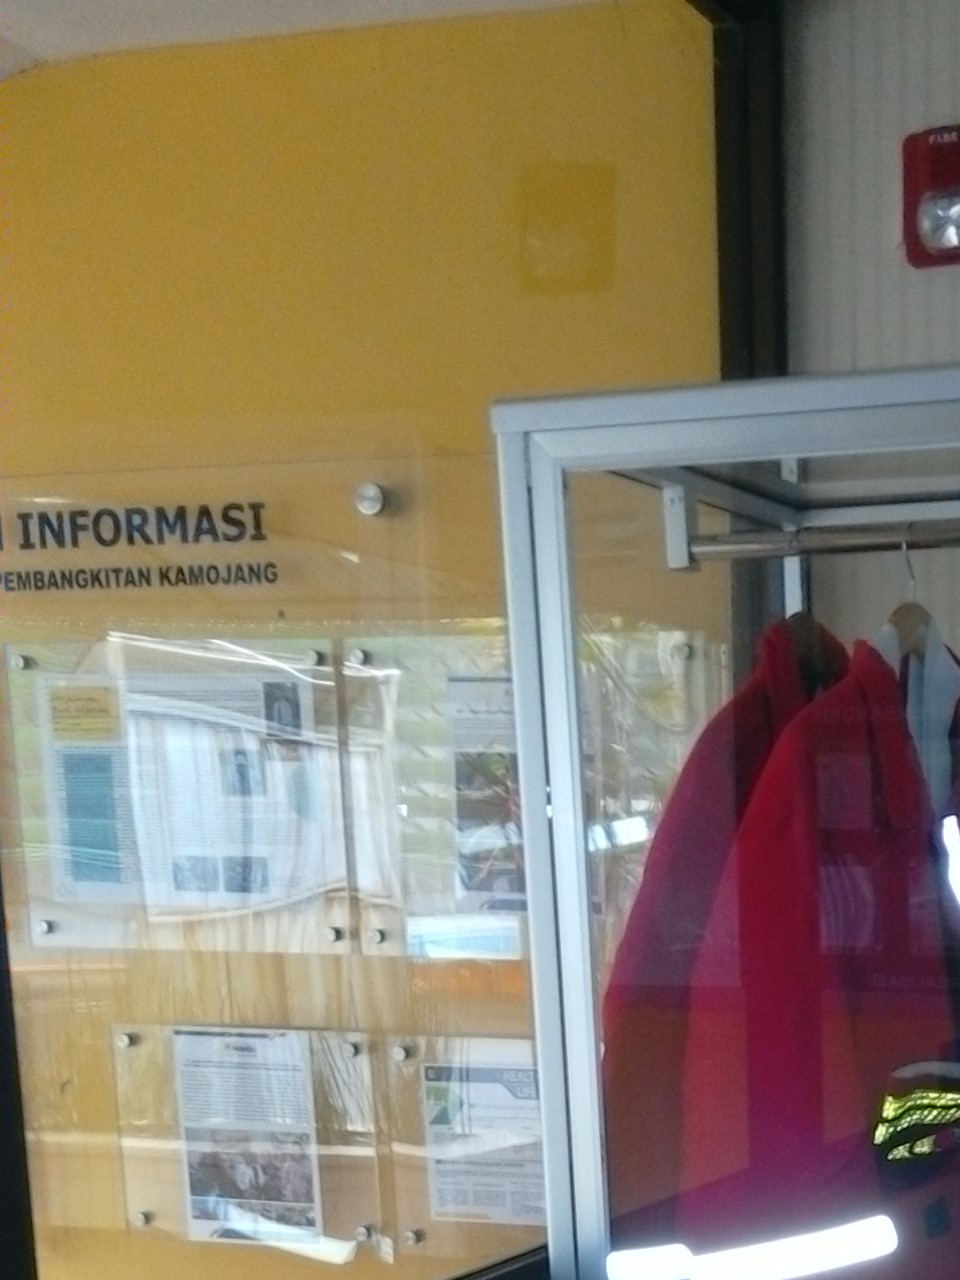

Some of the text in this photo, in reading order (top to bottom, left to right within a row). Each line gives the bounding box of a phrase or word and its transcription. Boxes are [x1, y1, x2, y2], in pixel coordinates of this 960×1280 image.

[16, 502, 268, 550] INFORMASI
[0, 562, 279, 592] EMBANGKITAN KAMOJANG
